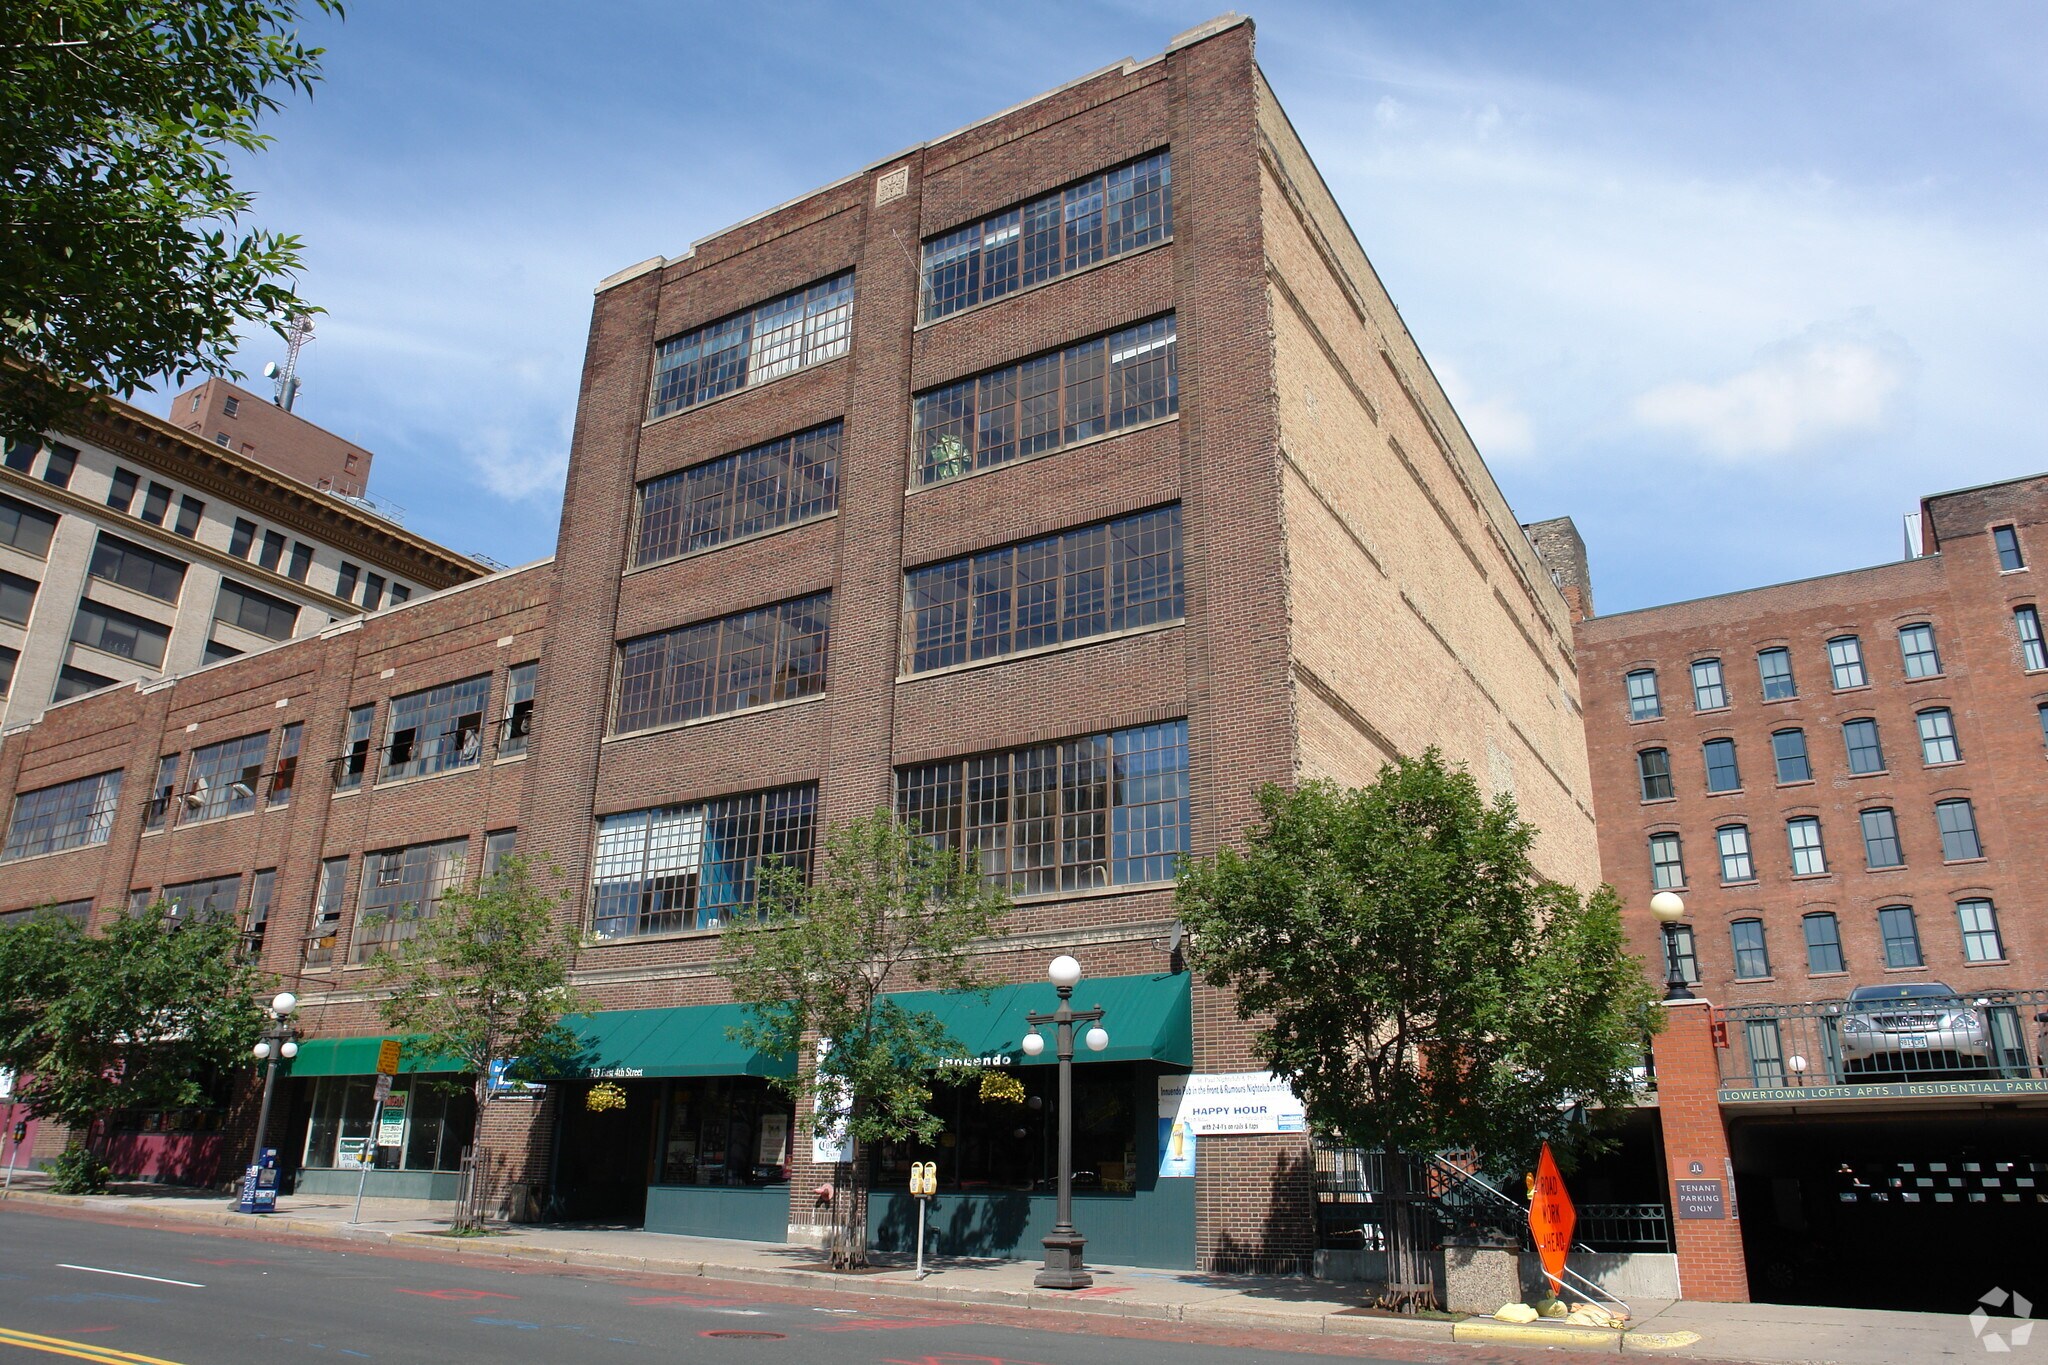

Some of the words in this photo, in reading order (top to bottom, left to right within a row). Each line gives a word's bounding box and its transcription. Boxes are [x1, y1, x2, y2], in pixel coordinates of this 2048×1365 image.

[614, 1067, 625, 1077] 4th
[626, 1067, 643, 1077] Street
[1160, 1086, 1182, 1096] Innuendo
[1224, 1084, 1246, 1094] Rumours
[1246, 1083, 1270, 1095] Nightclub
[1724, 1090, 1805, 1100] LOWERTOWN
[1811, 1088, 1851, 1098] LOFTS
[1857, 1086, 1894, 1096] APTS.
[1910, 1083, 2000, 1094] RESIDENTIAL
[1192, 1107, 1230, 1116] HAPPY
[1234, 1106, 1268, 1115] HOUR
[1541, 1176, 1557, 1195] ROAD
[1542, 1204, 1560, 1223] WORK
[1543, 1232, 1565, 1252] AHEAD
